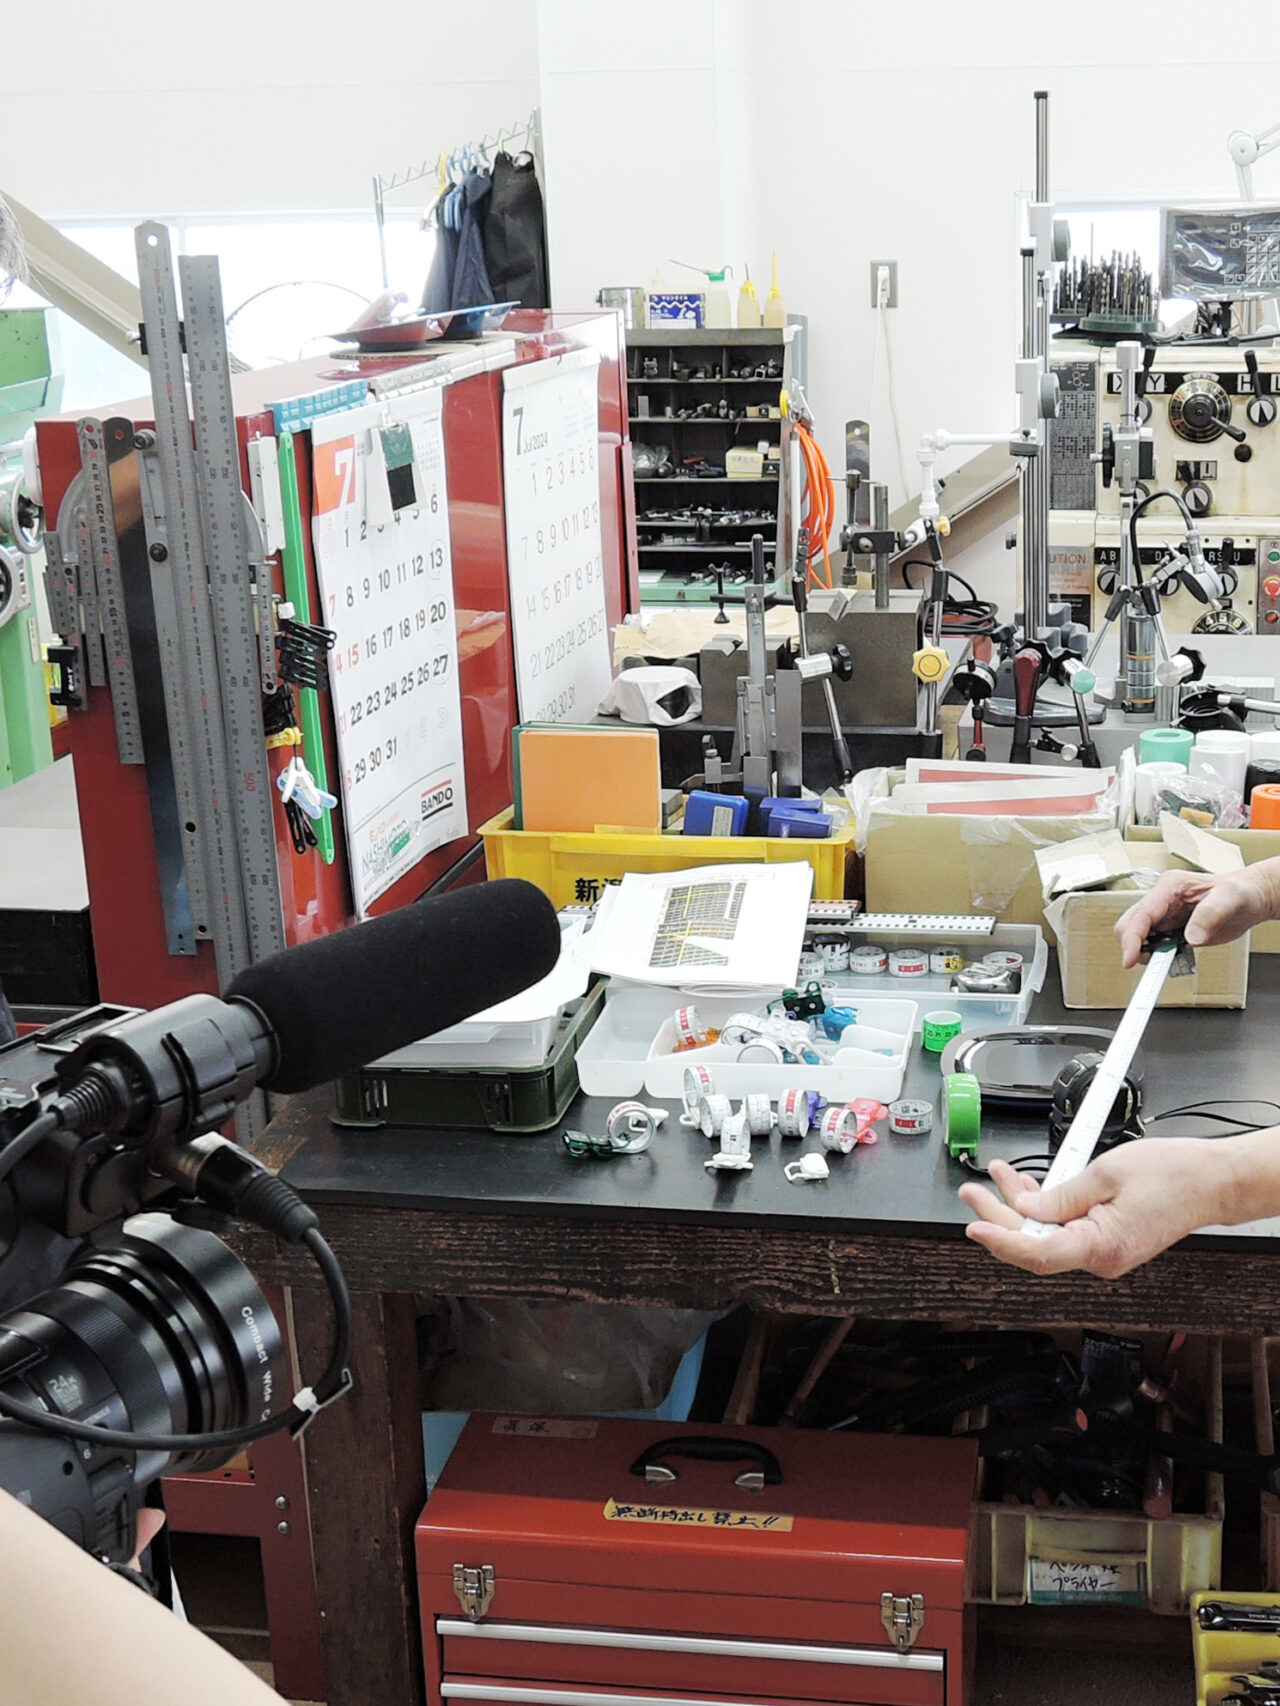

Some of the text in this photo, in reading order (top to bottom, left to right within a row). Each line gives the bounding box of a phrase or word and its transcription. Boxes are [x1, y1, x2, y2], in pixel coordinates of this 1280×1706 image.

[1149, 375, 1162, 390] Y
[1241, 376, 1253, 391] H
[513, 407, 523, 456] 7
[334, 448, 353, 509] 7
[546, 465, 553, 490] 2
[345, 527, 349, 547] 1
[360, 520, 367, 540] 2
[431, 494, 438, 513] 6
[536, 530, 544, 554] 8
[550, 524, 556, 548] 9
[1049, 553, 1087, 564] UTION
[1100, 551, 1116, 560] A B
[1234, 551, 1240, 561] U
[329, 547, 443, 616] 7 8 9 10 11 12 13
[1206, 616, 1214, 625] 4
[1220, 613, 1227, 622] 5
[347, 643, 359, 667] 15
[366, 634, 377, 658] 16
[382, 625, 393, 649] 17
[399, 617, 410, 640] 18
[415, 609, 425, 631] 19
[431, 601, 446, 624] 20
[530, 652, 541, 678] 21
[545, 643, 555, 670] 22
[556, 635, 565, 661] 23
[566, 628, 576, 654] 24
[577, 621, 587, 646] 25
[350, 702, 362, 726] 22
[366, 690, 380, 716] 23
[384, 680, 397, 706] 24
[401, 671, 414, 696] 25
[417, 662, 429, 686] 26
[433, 654, 448, 677] 27
[355, 758, 366, 784] 29
[369, 747, 381, 771] 30
[386, 736, 397, 759] 31
[244, 772, 256, 791] 500
[421, 787, 453, 813] BANDO
[1053, 1576, 1117, 1592] プライヤー
